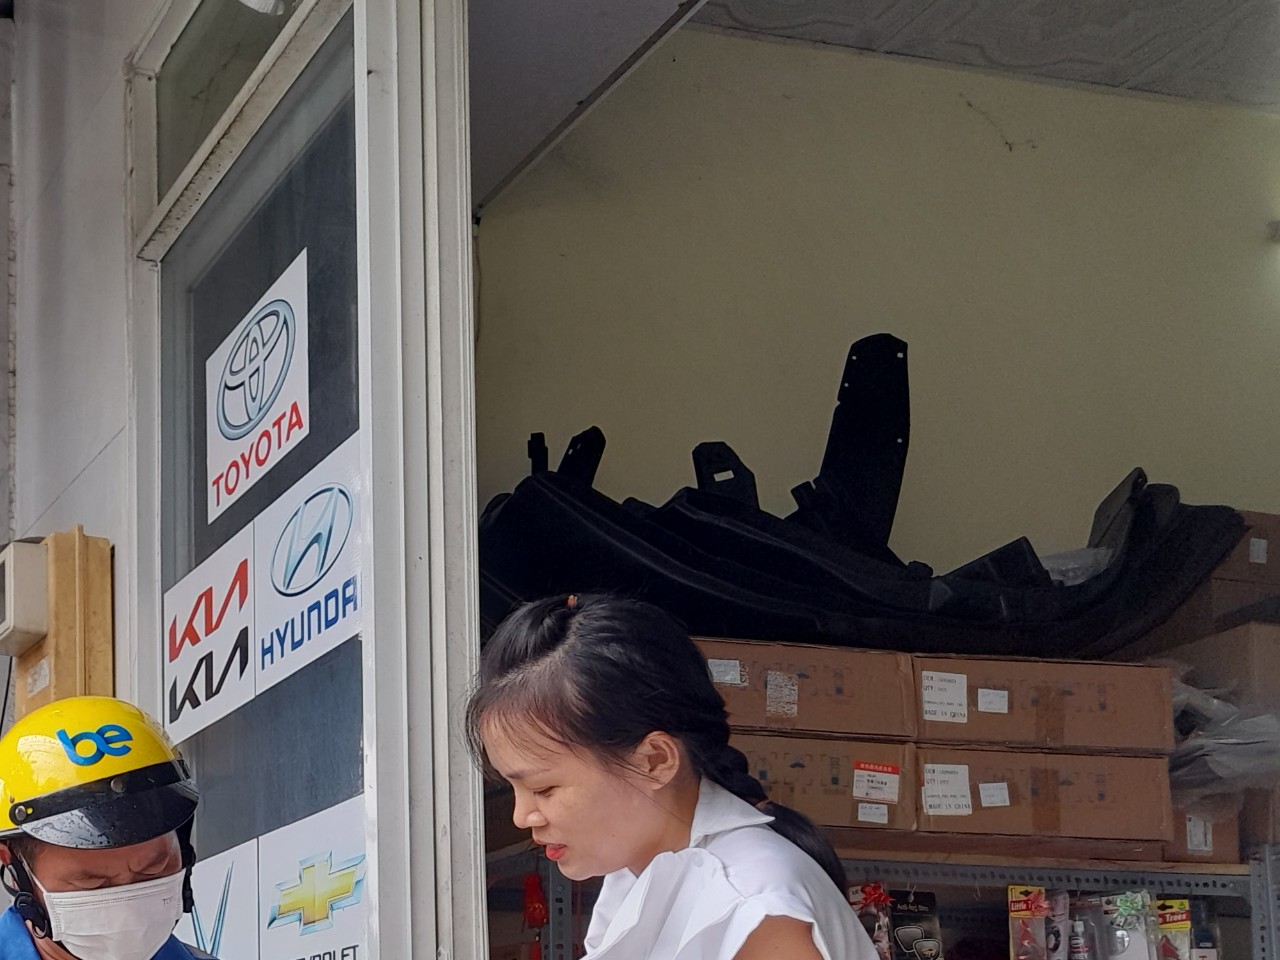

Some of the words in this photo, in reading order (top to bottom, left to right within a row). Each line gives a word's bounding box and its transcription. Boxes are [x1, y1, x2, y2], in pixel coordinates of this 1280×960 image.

[212, 400, 304, 507] TOYOTA
[261, 571, 362, 671] HYUNDA
[56, 723, 134, 767] be
